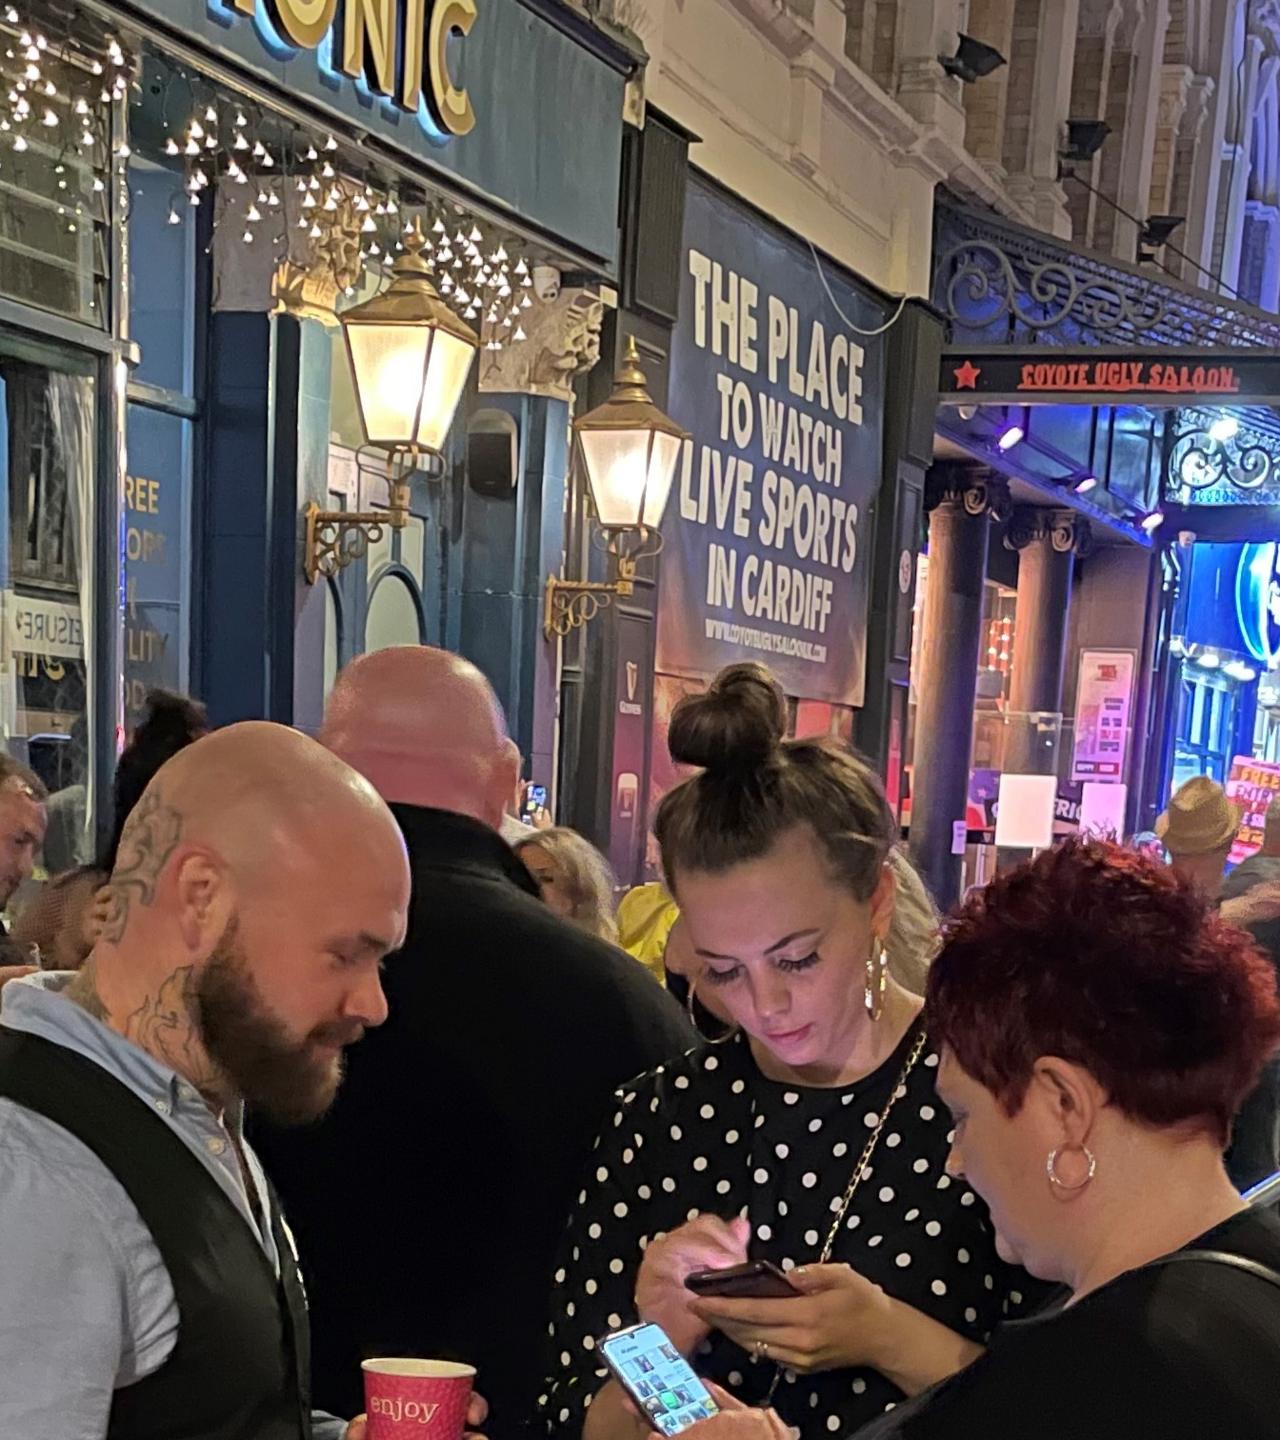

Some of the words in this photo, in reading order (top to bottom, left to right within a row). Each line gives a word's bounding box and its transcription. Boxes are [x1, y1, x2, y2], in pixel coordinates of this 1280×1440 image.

[689, 249, 758, 373] THE
[768, 295, 864, 425] PLACE
[1022, 363, 1089, 386] COYOTE
[1095, 362, 1145, 388] UGLY
[1150, 365, 1234, 390] SALOON
[717, 373, 753, 449] TO
[758, 392, 842, 487] WATCH
[125, 477, 160, 514] REE
[680, 439, 753, 537] LIVE
[759, 470, 857, 573] SPORTS
[706, 543, 737, 609] IN
[742, 555, 833, 633] CARDIFF
[1236, 784, 1274, 804] ENTR
[371, 1396, 438, 1424] enjoy
